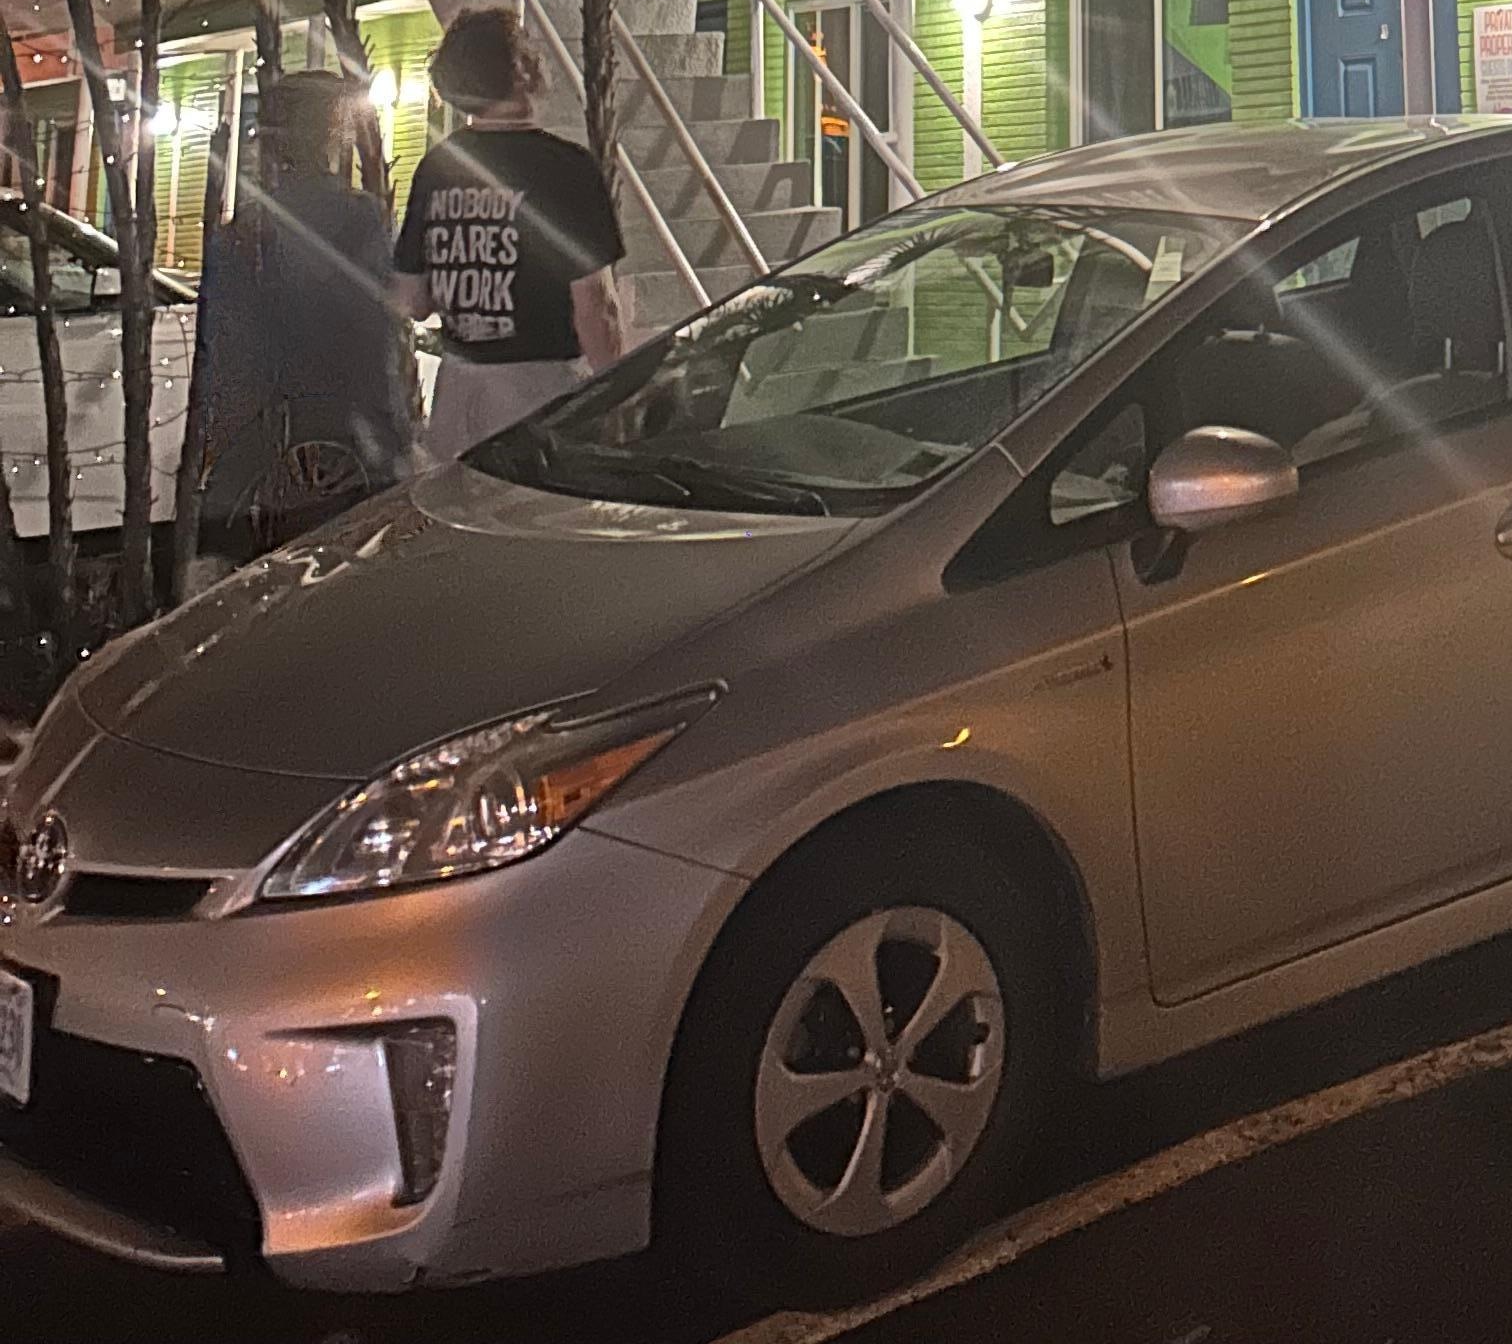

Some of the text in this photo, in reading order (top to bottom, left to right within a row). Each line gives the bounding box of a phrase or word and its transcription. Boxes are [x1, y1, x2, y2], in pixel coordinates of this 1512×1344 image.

[430, 187, 526, 222] NOBODY
[430, 224, 519, 266] CARES
[430, 268, 517, 311] WORK
